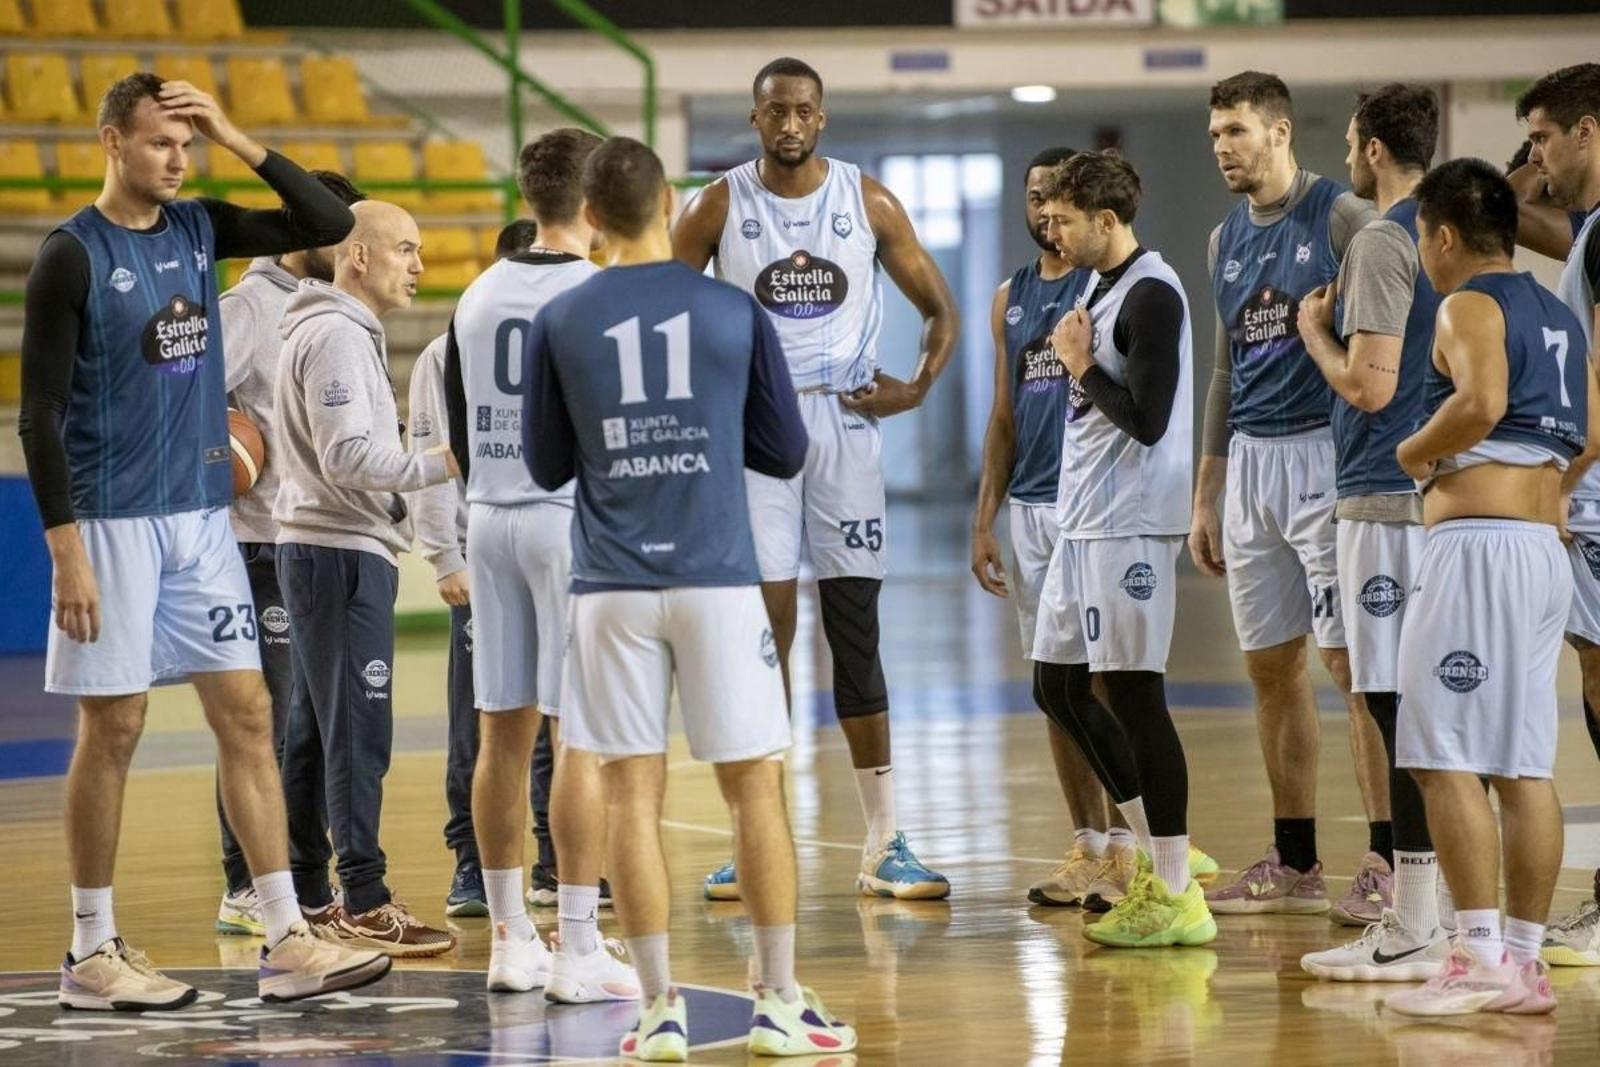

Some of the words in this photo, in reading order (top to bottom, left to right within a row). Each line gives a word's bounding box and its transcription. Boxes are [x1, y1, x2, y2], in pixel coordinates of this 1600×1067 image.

[769, 269, 834, 287] Estrella
[772, 285, 832, 303] Galicia
[603, 311, 694, 405] 11
[1542, 326, 1572, 408] 7
[493, 420, 509, 431] DE
[629, 414, 679, 431] XUNTA
[629, 431, 649, 446] DE
[652, 426, 710, 443] GALICIA
[839, 517, 883, 552] 35
[207, 603, 257, 643] 23
[1086, 606, 1100, 641] 0
